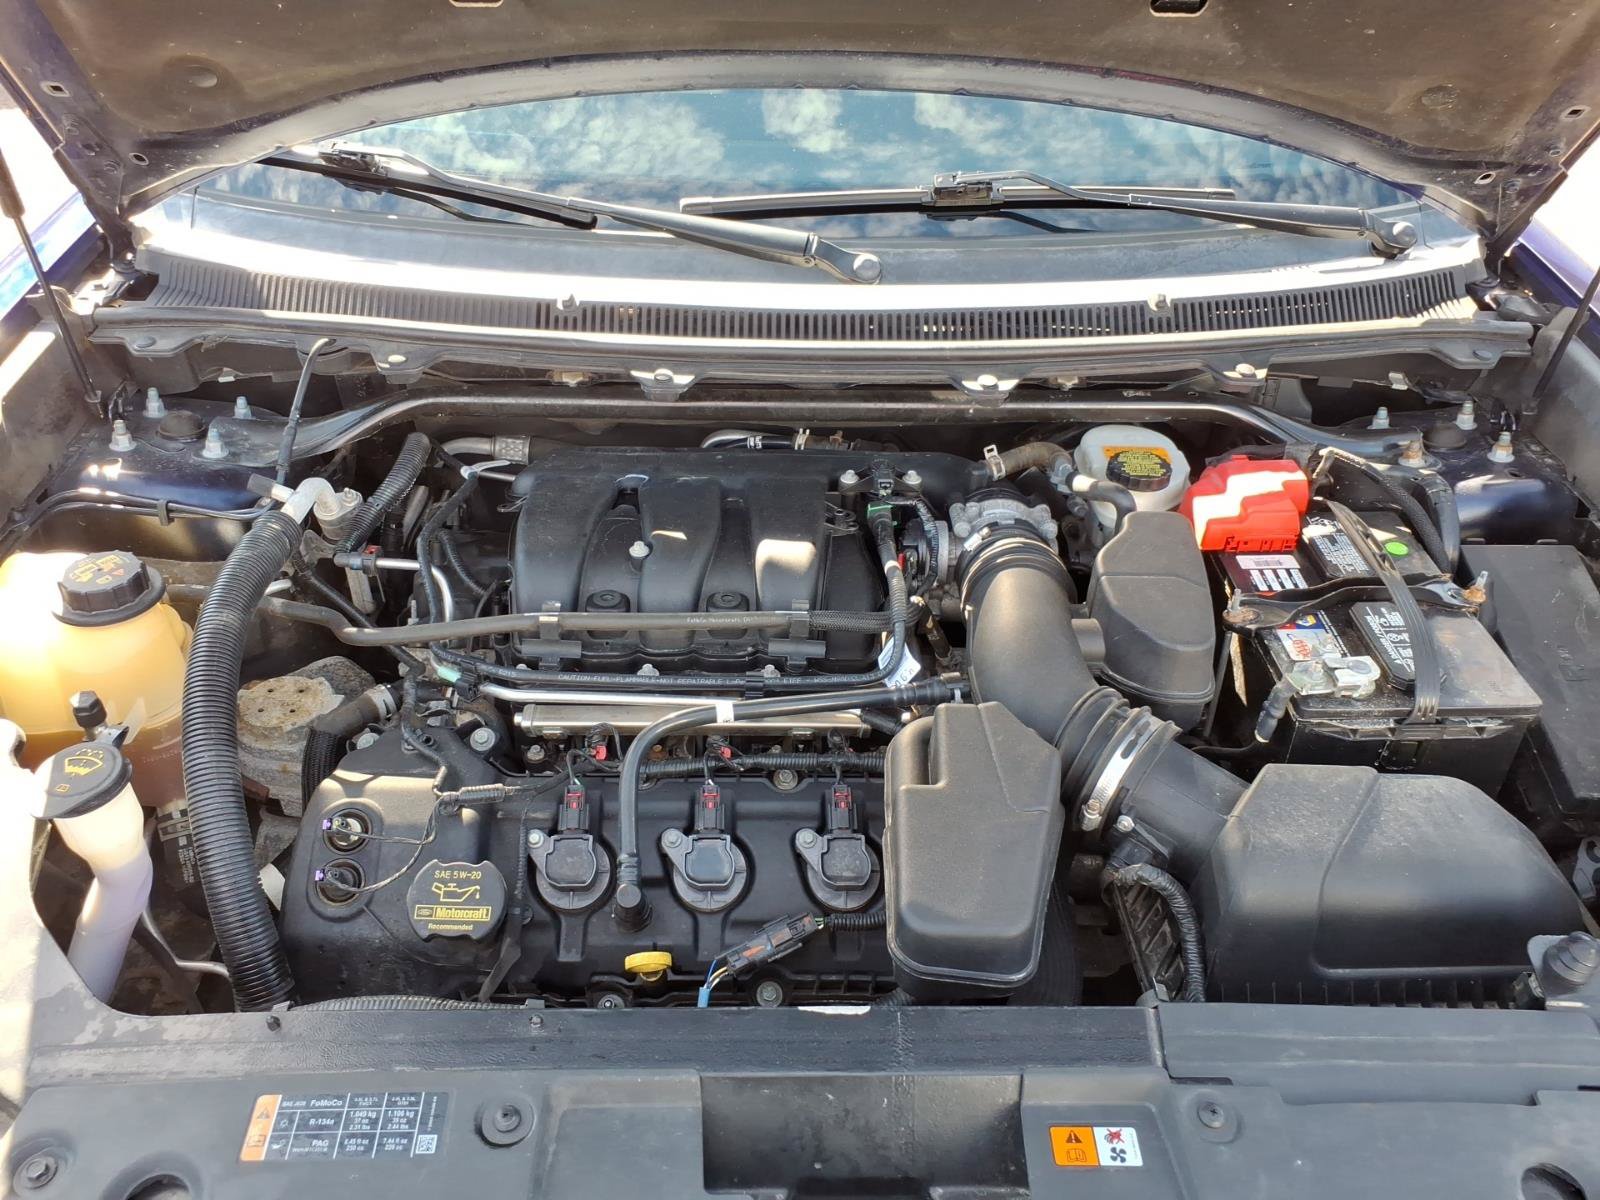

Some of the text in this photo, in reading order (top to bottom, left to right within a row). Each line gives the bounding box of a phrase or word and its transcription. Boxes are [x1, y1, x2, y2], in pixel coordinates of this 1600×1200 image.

[434, 870, 481, 879] SAE 5W-20
[435, 907, 488, 919] Motorcraft
[428, 923, 473, 931] Recommended
